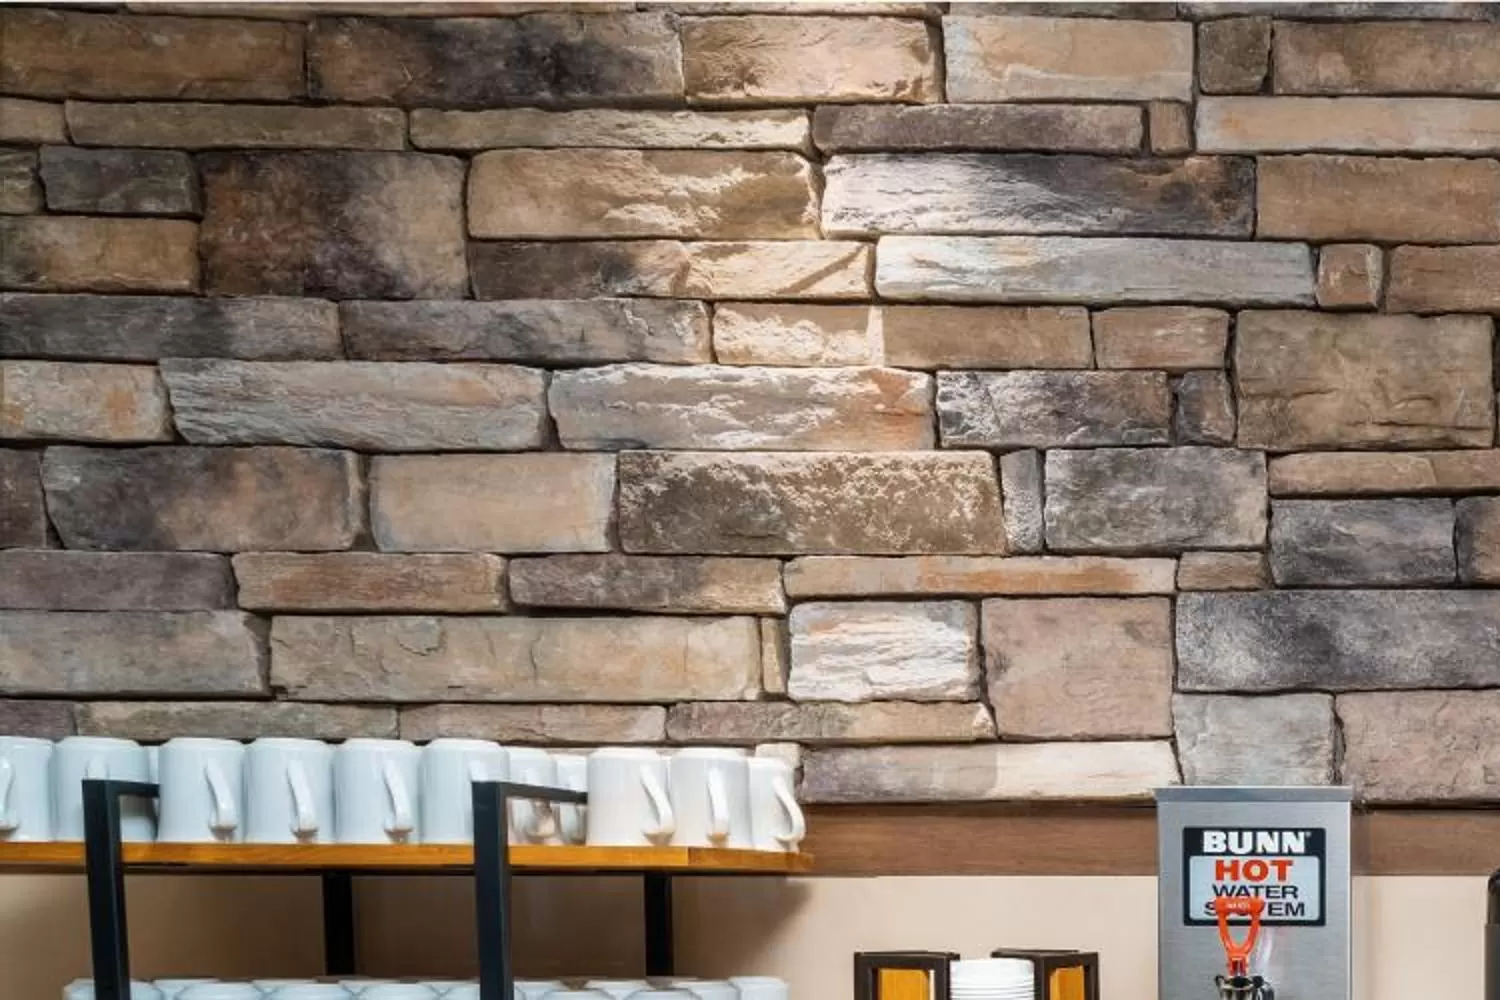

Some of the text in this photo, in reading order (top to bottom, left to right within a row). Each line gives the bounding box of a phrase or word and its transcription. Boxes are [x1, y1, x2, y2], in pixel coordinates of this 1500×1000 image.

[1203, 831, 1305, 854] BUNN
[1215, 859, 1294, 882] HOT
[1212, 884, 1299, 898] WATER
[1204, 902, 1305, 916] SEM
